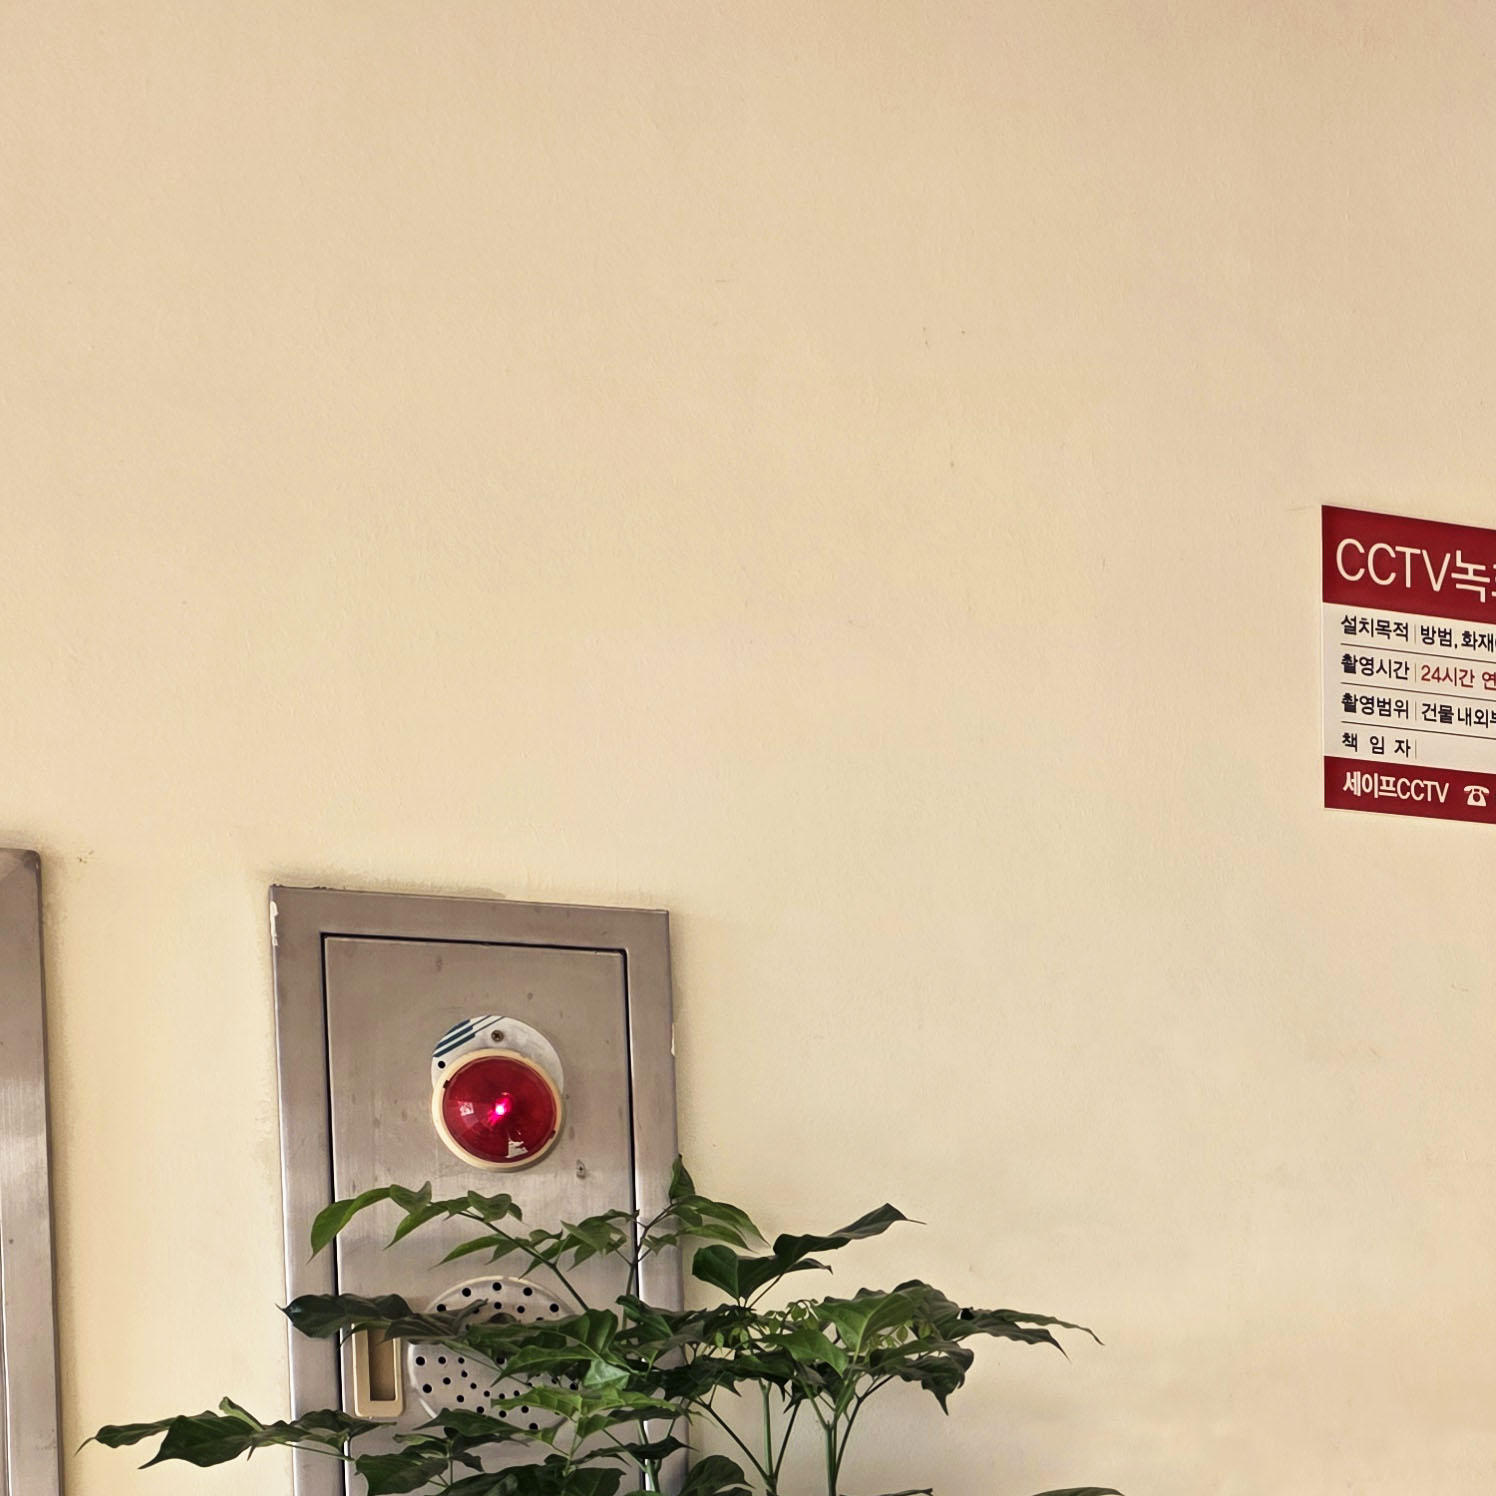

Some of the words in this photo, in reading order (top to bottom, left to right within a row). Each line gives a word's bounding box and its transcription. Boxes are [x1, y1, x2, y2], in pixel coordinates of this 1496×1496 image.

[1340, 614, 1409, 642] 설치목적
[1340, 653, 1410, 681] 촬영시간
[1420, 664, 1475, 689] 24시간
[1340, 692, 1409, 720] 촬영범위
[1343, 770, 1450, 803] 세이프CCTV
